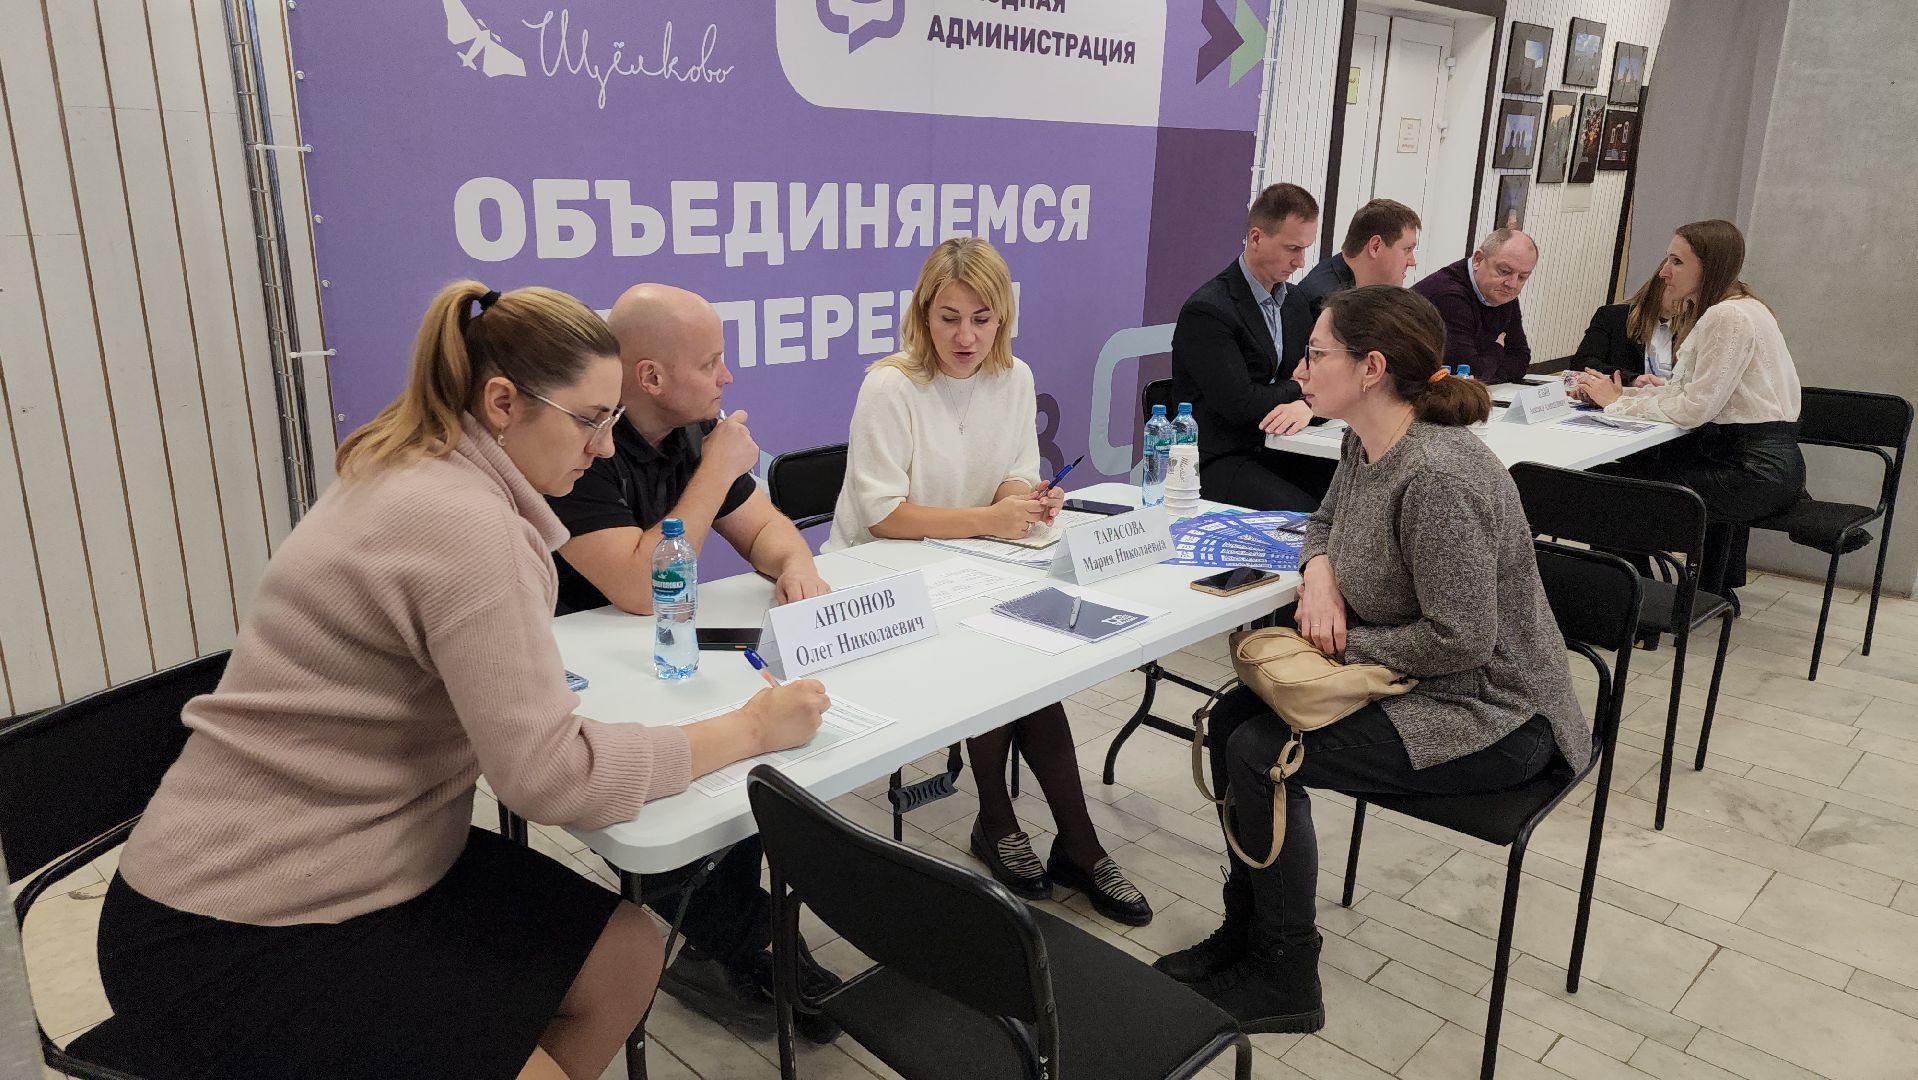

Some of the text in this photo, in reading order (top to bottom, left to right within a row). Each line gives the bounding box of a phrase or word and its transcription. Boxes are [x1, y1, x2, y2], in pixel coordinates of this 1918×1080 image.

[926, 14, 1136, 67] АДМИНИСТРАЦИЯ
[453, 176, 1091, 268] ОБЪЕДИНЯЕМСЯ
[709, 281, 1021, 369] ПЕРЕ
[1083, 539, 1167, 572] Мария Николаевна
[1093, 520, 1146, 545] ТАРАСОВА
[814, 588, 896, 629] АНТОНОВ
[796, 616, 925, 667] Олег Николаевич
